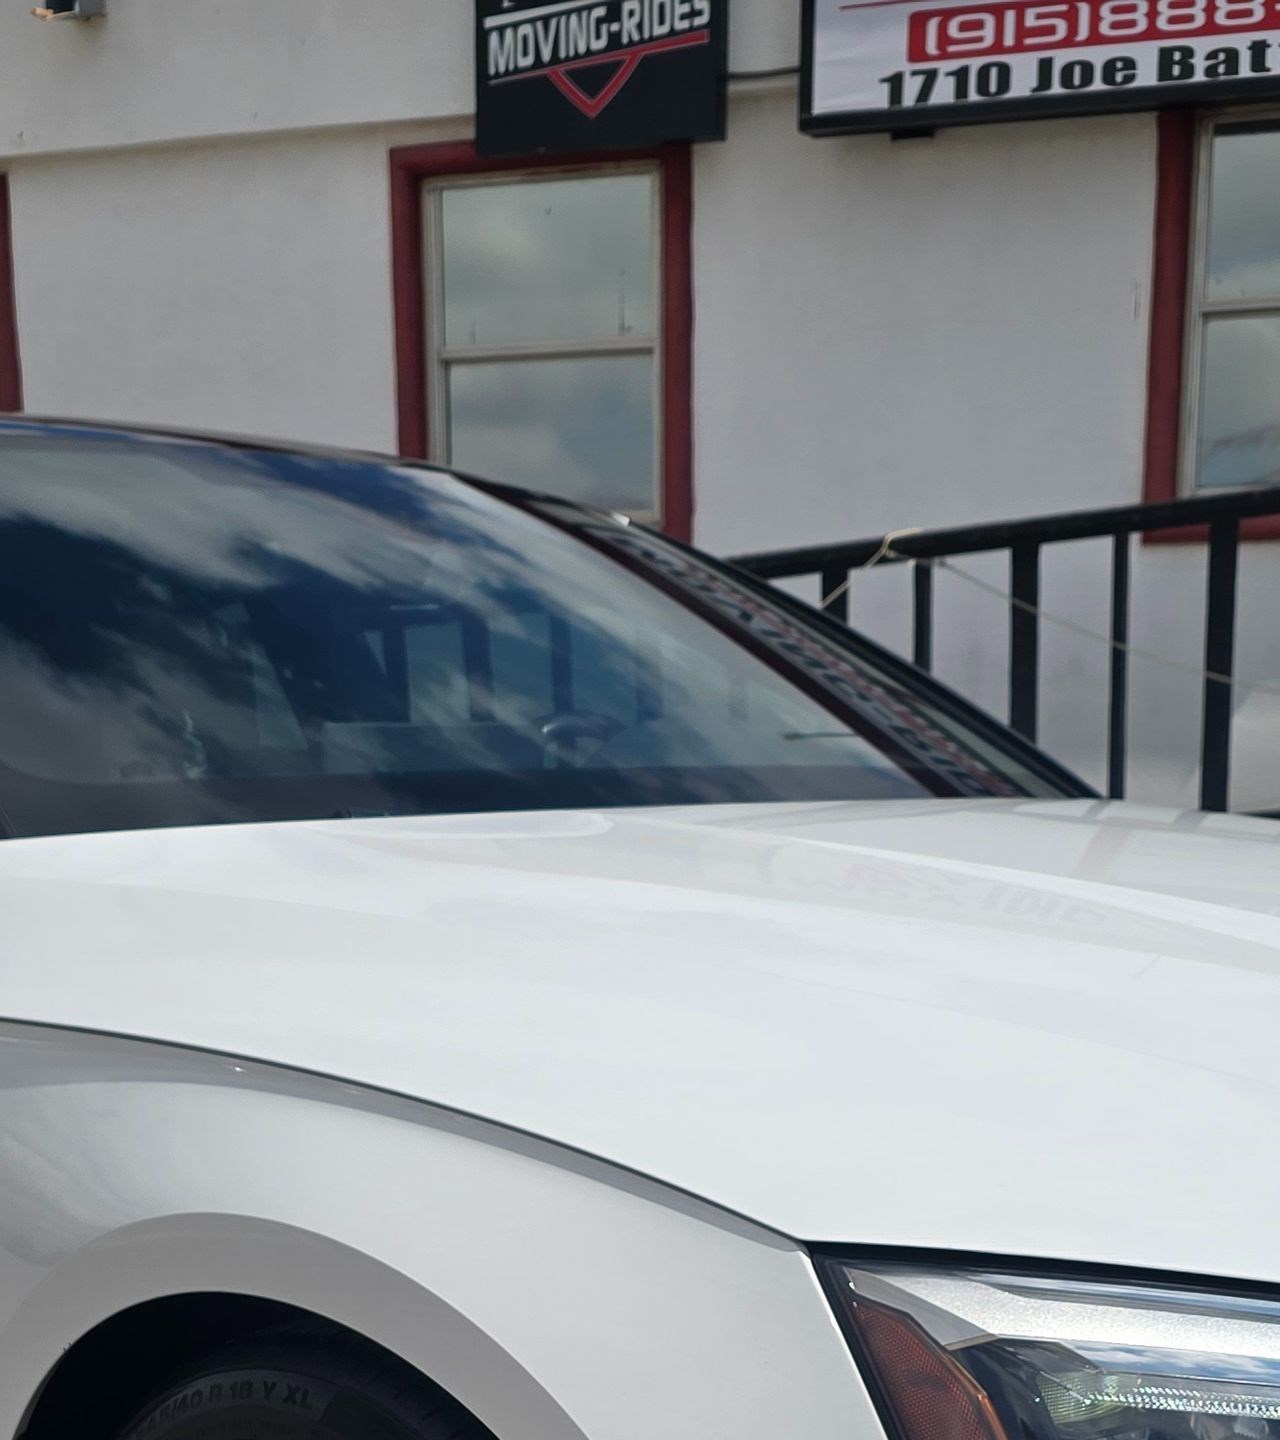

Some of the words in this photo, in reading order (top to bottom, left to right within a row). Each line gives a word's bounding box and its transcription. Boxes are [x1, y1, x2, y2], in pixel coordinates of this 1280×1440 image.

[487, 0, 711, 76] MOVING-RIDES
[878, 61, 1012, 109] 1710
[1030, 55, 1137, 95] Joe
[282, 1383, 313, 1411] XL
